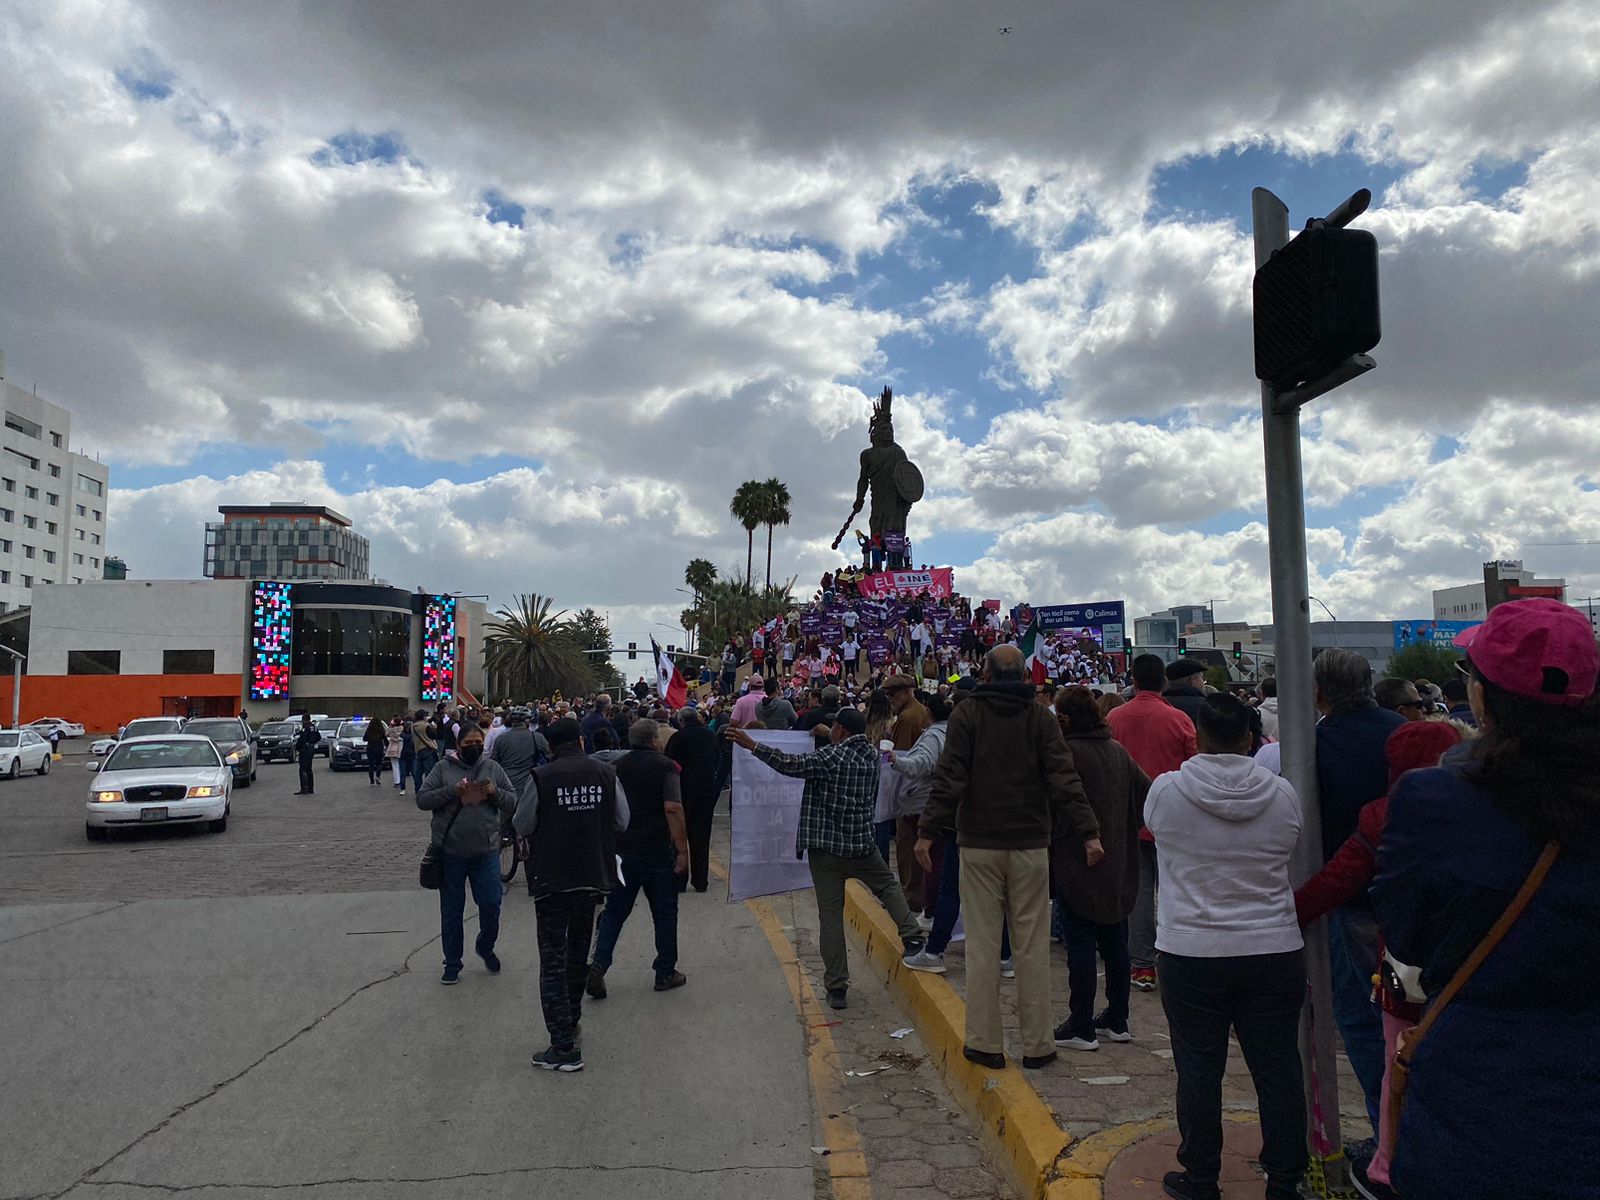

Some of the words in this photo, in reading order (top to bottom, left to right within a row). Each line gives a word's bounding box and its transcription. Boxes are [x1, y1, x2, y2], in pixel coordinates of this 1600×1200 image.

[875, 577, 893, 588] EL
[908, 574, 931, 583] INE
[1095, 609, 1117, 617] Calimax
[557, 785, 602, 796] BLANCO
[565, 795, 602, 805] NEGRO
